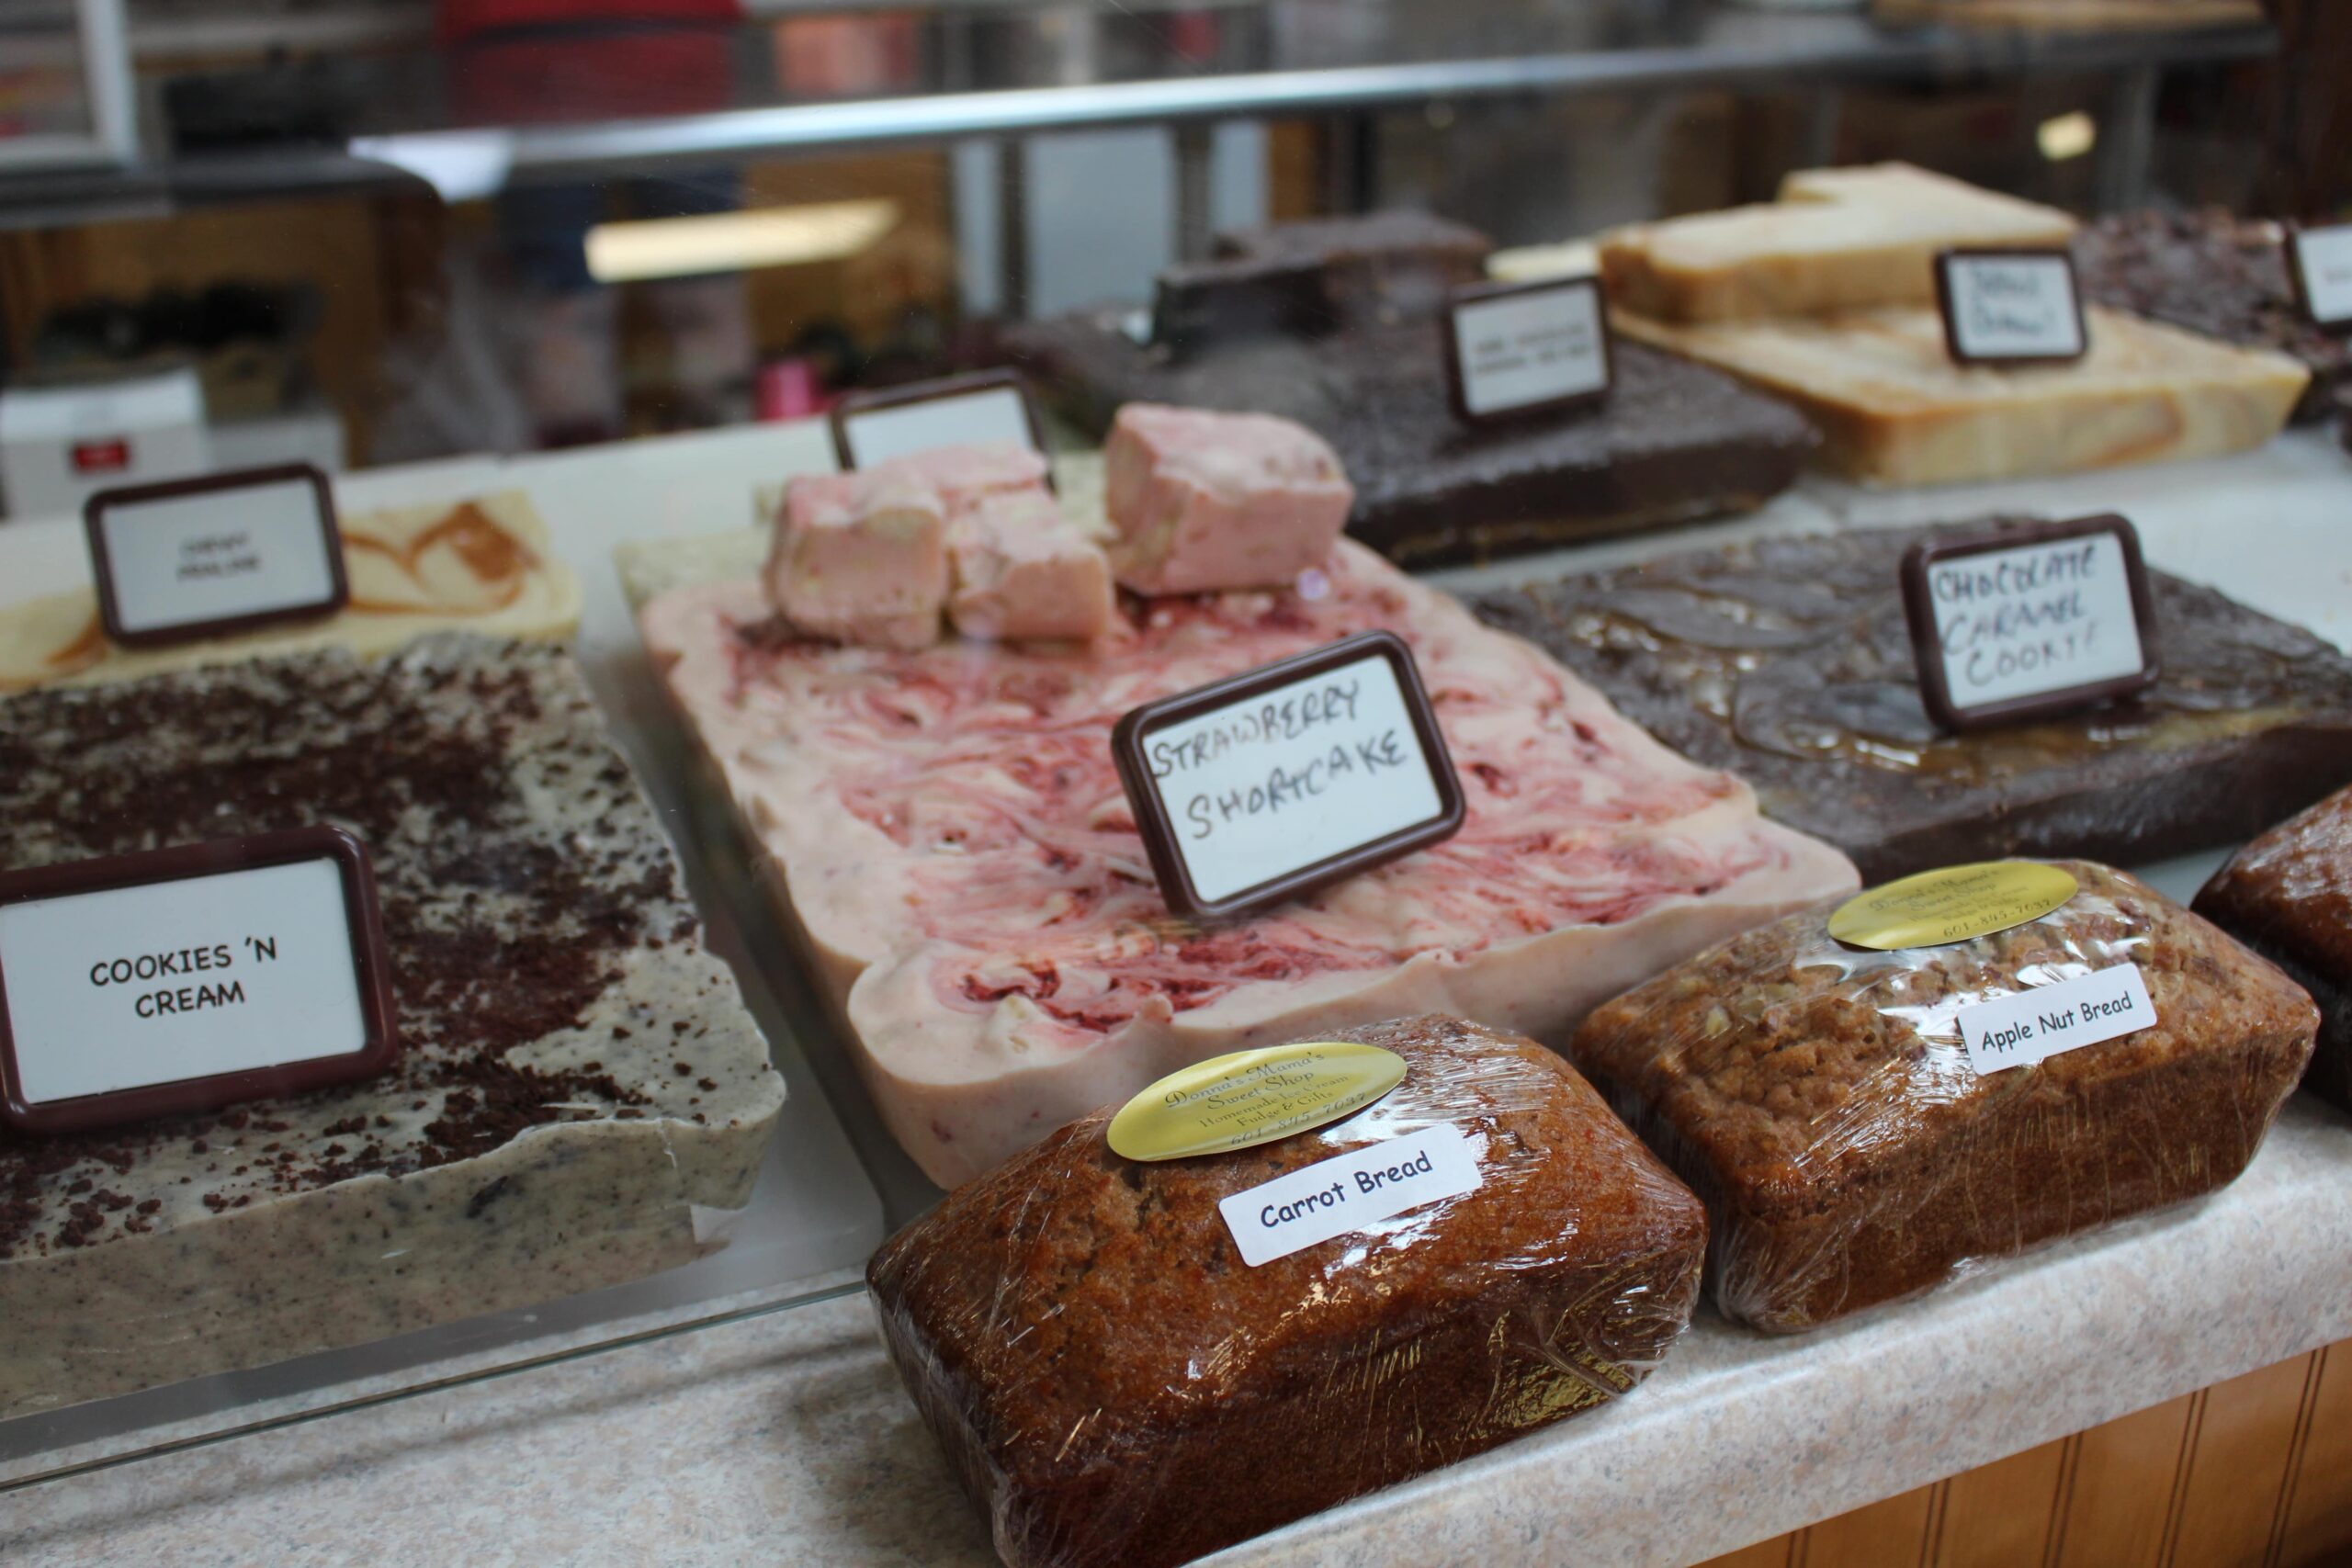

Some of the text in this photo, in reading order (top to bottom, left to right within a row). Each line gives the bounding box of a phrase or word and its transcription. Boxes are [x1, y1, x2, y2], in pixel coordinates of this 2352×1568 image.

[1936, 544, 2095, 603] CHOCOLATE
[1943, 590, 2086, 655] CARAMEL
[1152, 678, 1360, 779] STRAWBERRY
[1187, 729, 1407, 840] SHORTCAKE
[90, 944, 232, 987] COOKIES
[135, 981, 244, 1019] CREAM
[1982, 991, 2132, 1054] Apple Nut Bread
[1165, 1052, 1325, 1108] Donna's Mama's
[1207, 1072, 1314, 1110] Sweet Shop
[1237, 1090, 1334, 1127] Fudge & Gifts
[1199, 1097, 1278, 1128] Homemade
[1261, 1150, 1433, 1228] Carrot Bread
